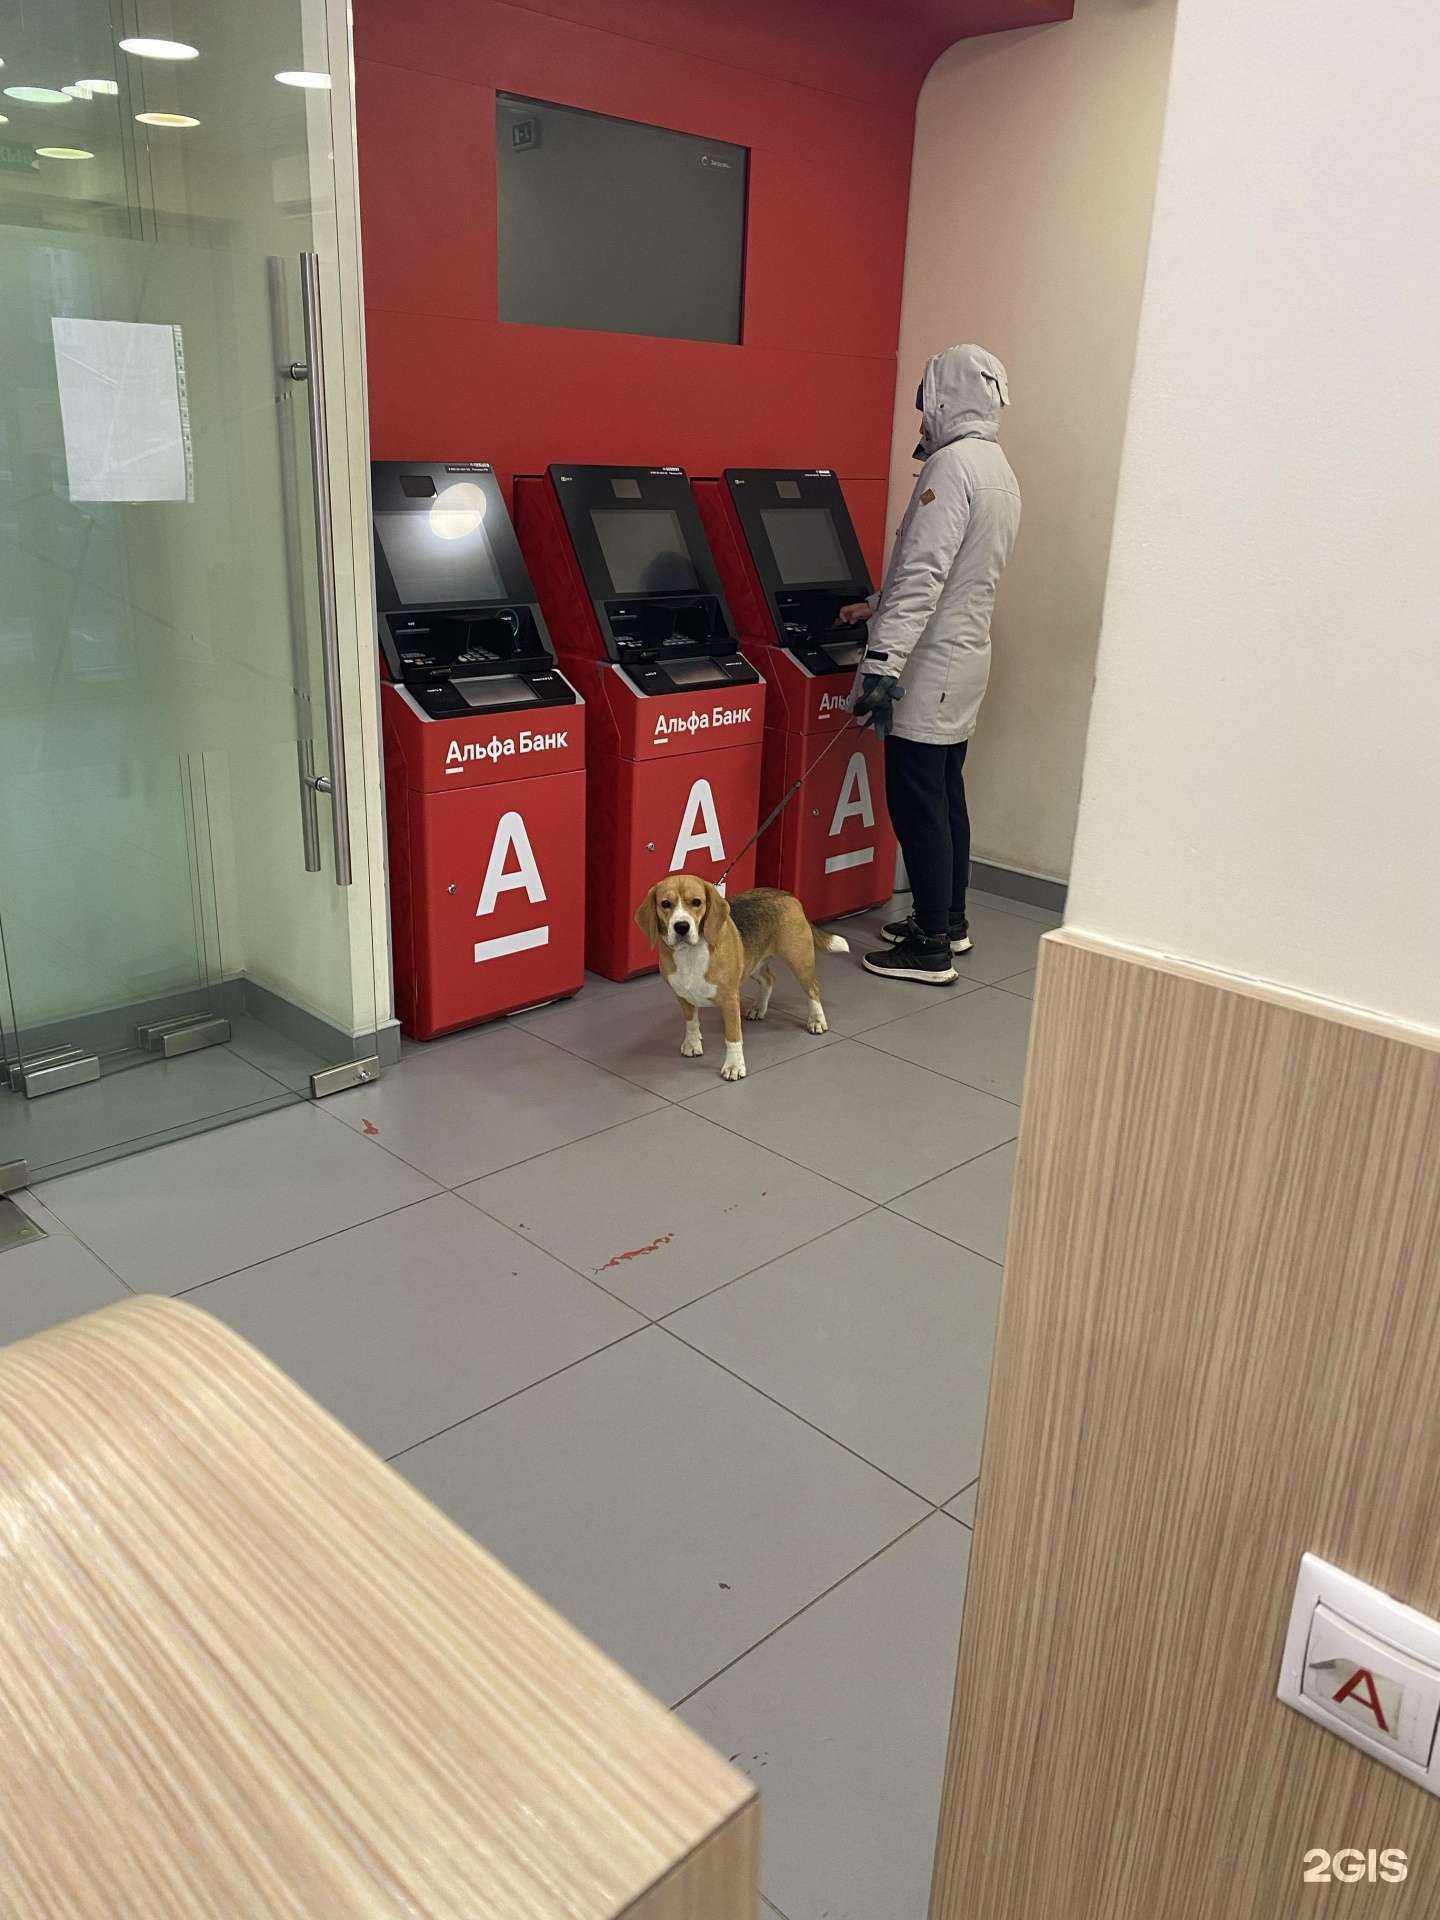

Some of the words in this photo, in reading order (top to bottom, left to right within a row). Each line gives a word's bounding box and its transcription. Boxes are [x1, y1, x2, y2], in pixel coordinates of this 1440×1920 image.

[654, 711, 709, 735] Альфа
[713, 707, 752, 727] Банк
[446, 736, 515, 764] Альфа
[519, 731, 569, 753] Банк
